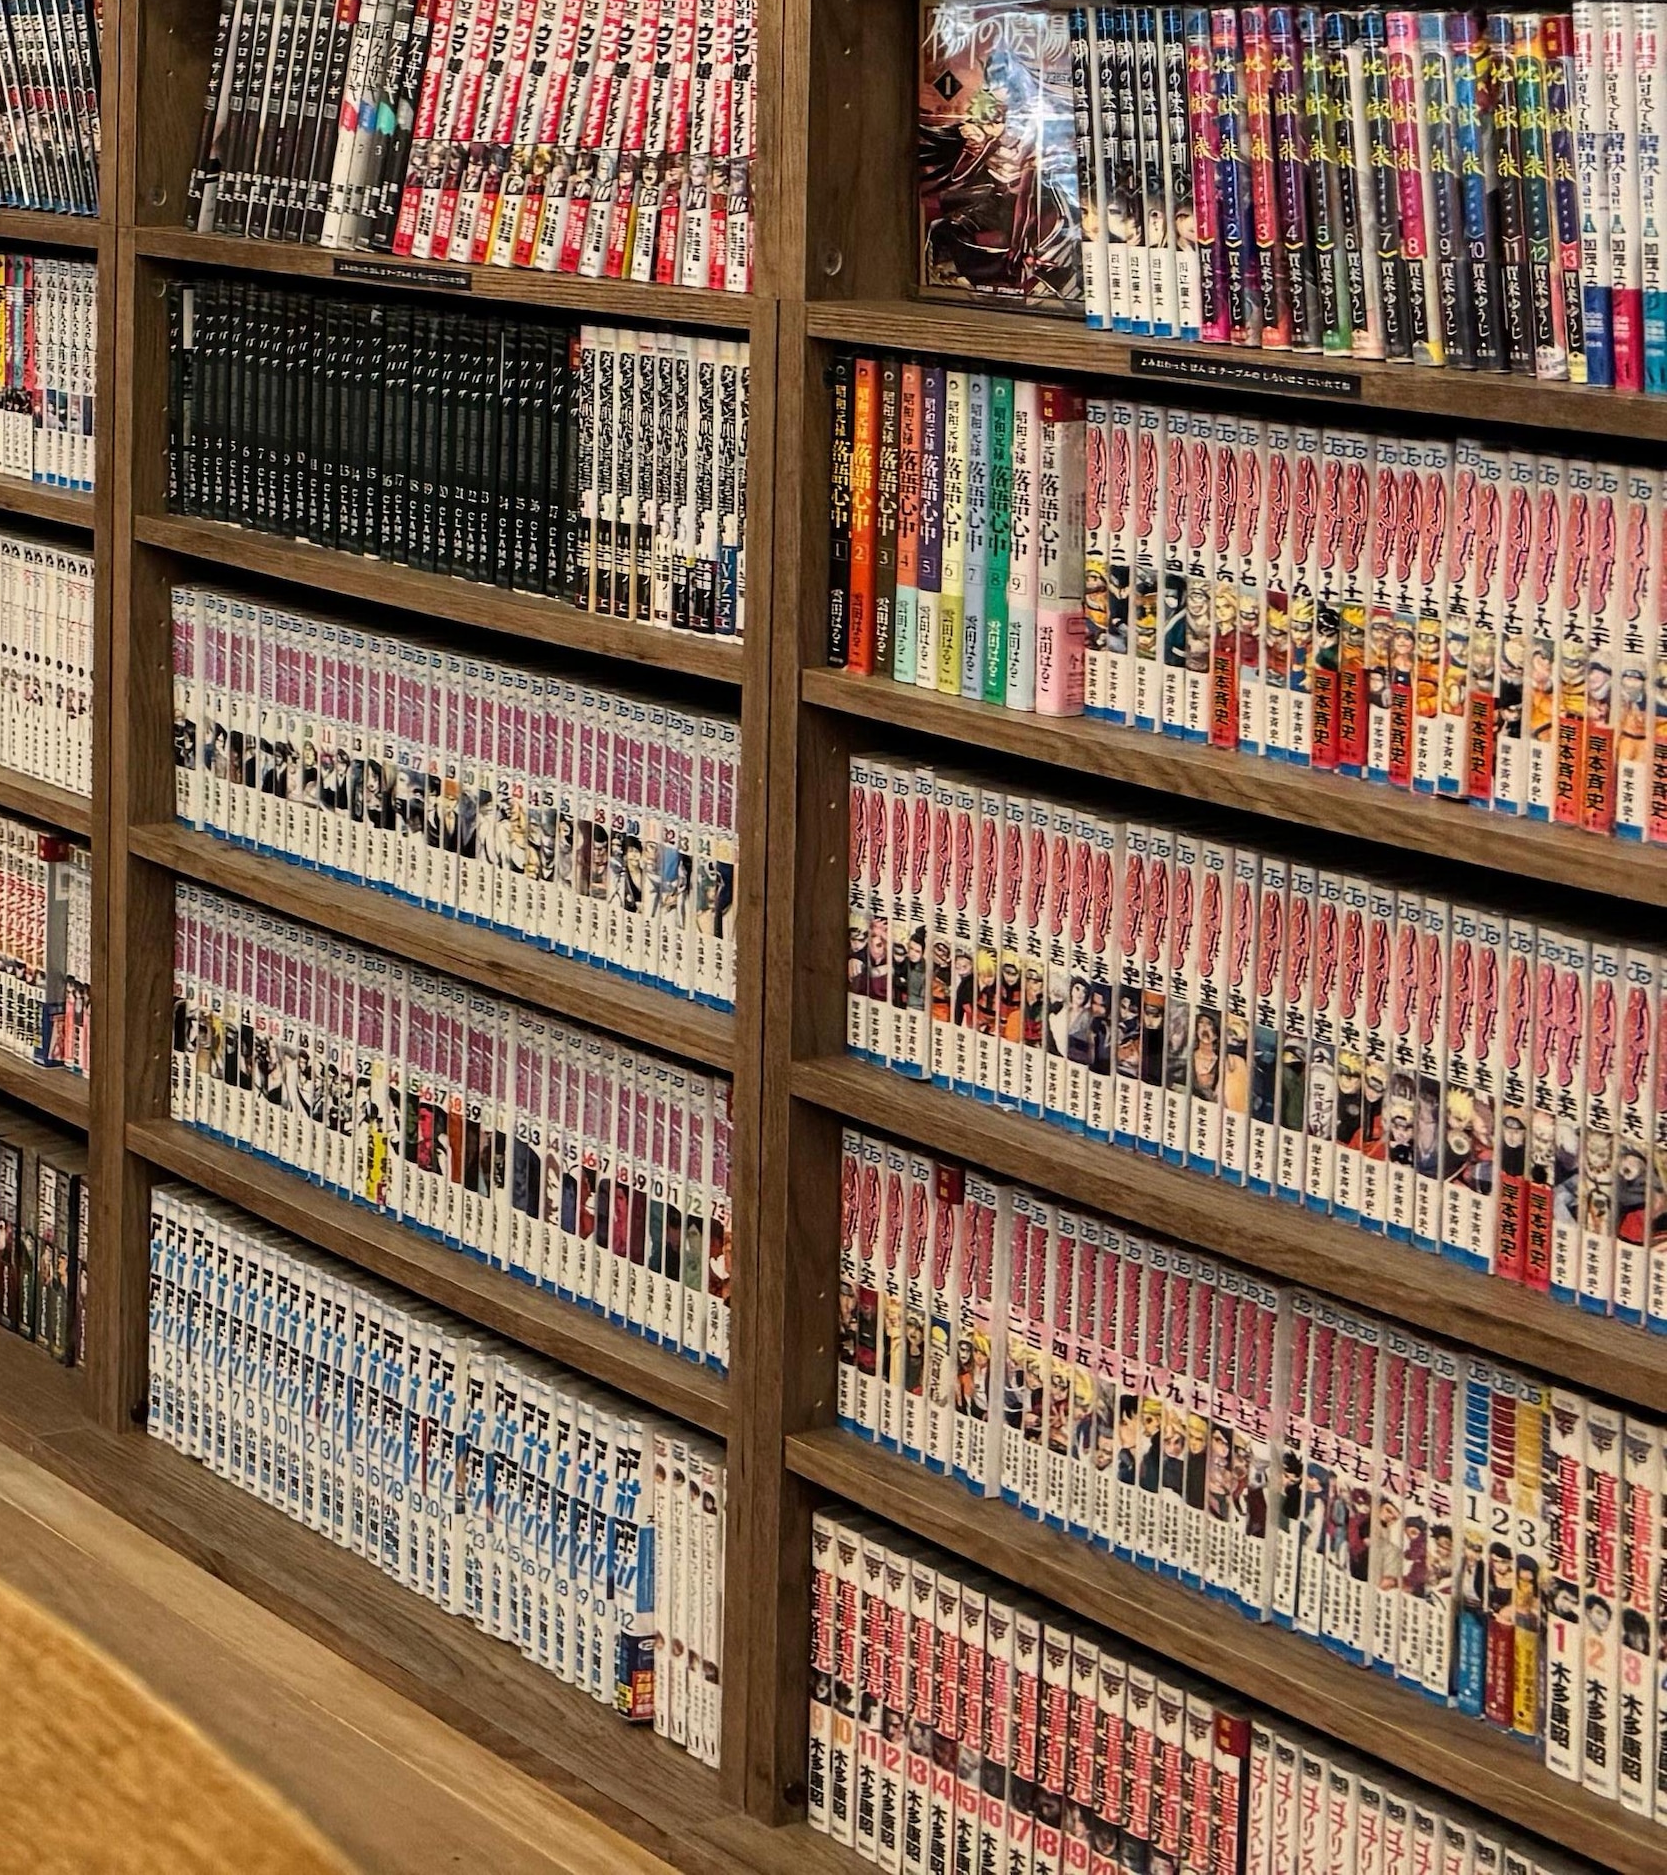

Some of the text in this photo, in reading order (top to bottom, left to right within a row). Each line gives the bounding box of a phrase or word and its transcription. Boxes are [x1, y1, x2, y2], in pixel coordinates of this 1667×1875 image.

[1408, 237, 1419, 253] 8
[1504, 243, 1518, 261] 11
[1531, 243, 1548, 262] 12
[1562, 248, 1577, 266] 13
[256, 468, 265, 515] CLAMP
[268, 471, 277, 518] CLAMP
[831, 440, 849, 529] 落語心中
[851, 444, 872, 532] 落語心中
[878, 447, 898, 536] 落語心中
[340, 484, 348, 533] CLAMP
[943, 456, 964, 549] 落語心中
[1011, 468, 1031, 561] 落語心中
[720, 546, 732, 616] TVアニメ
[1040, 585, 1053, 598] 10
[1468, 1496, 1478, 1521] 1
[1492, 1508, 1509, 1534] 2
[1518, 1520, 1536, 1547] 3
[1554, 1623, 1565, 1652] 1
[1586, 1639, 1604, 1672] 2
[1622, 1652, 1642, 1686] 3
[834, 1718, 851, 1743] 10
[859, 1732, 876, 1759] 11
[883, 1743, 900, 1772] 12
[908, 1754, 927, 1784] 13
[981, 1796, 1001, 1826] 16
